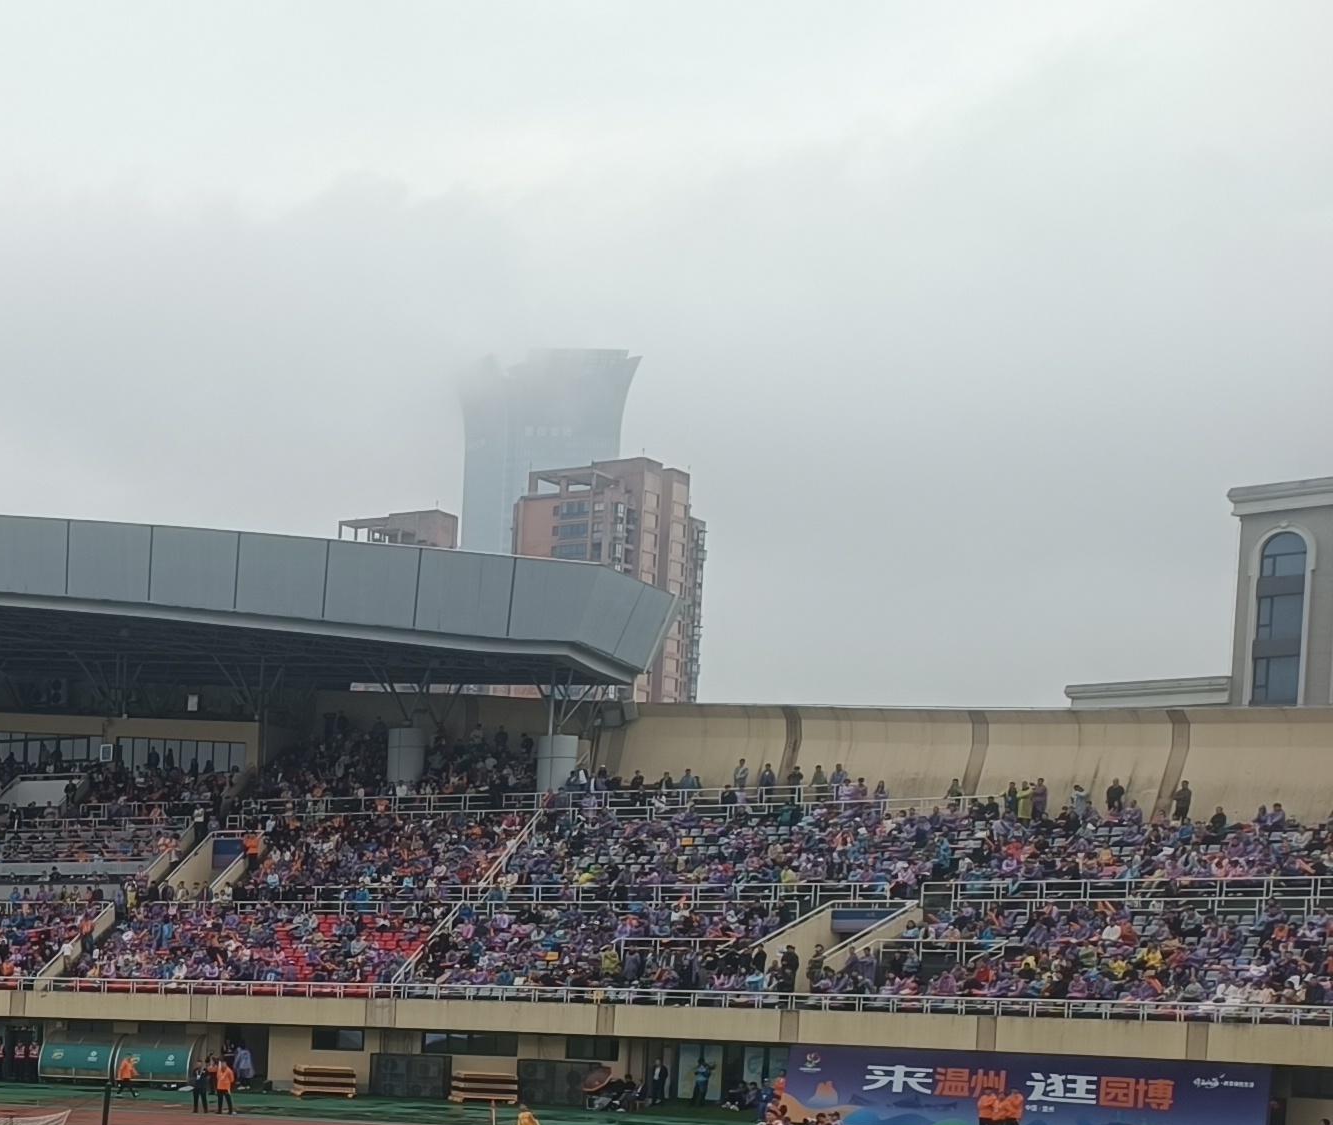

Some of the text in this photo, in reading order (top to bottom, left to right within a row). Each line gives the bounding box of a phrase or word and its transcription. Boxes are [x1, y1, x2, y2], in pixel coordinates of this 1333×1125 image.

[862, 1064, 1007, 1098] 来温州
[1026, 1072, 1175, 1110] 逛园博
